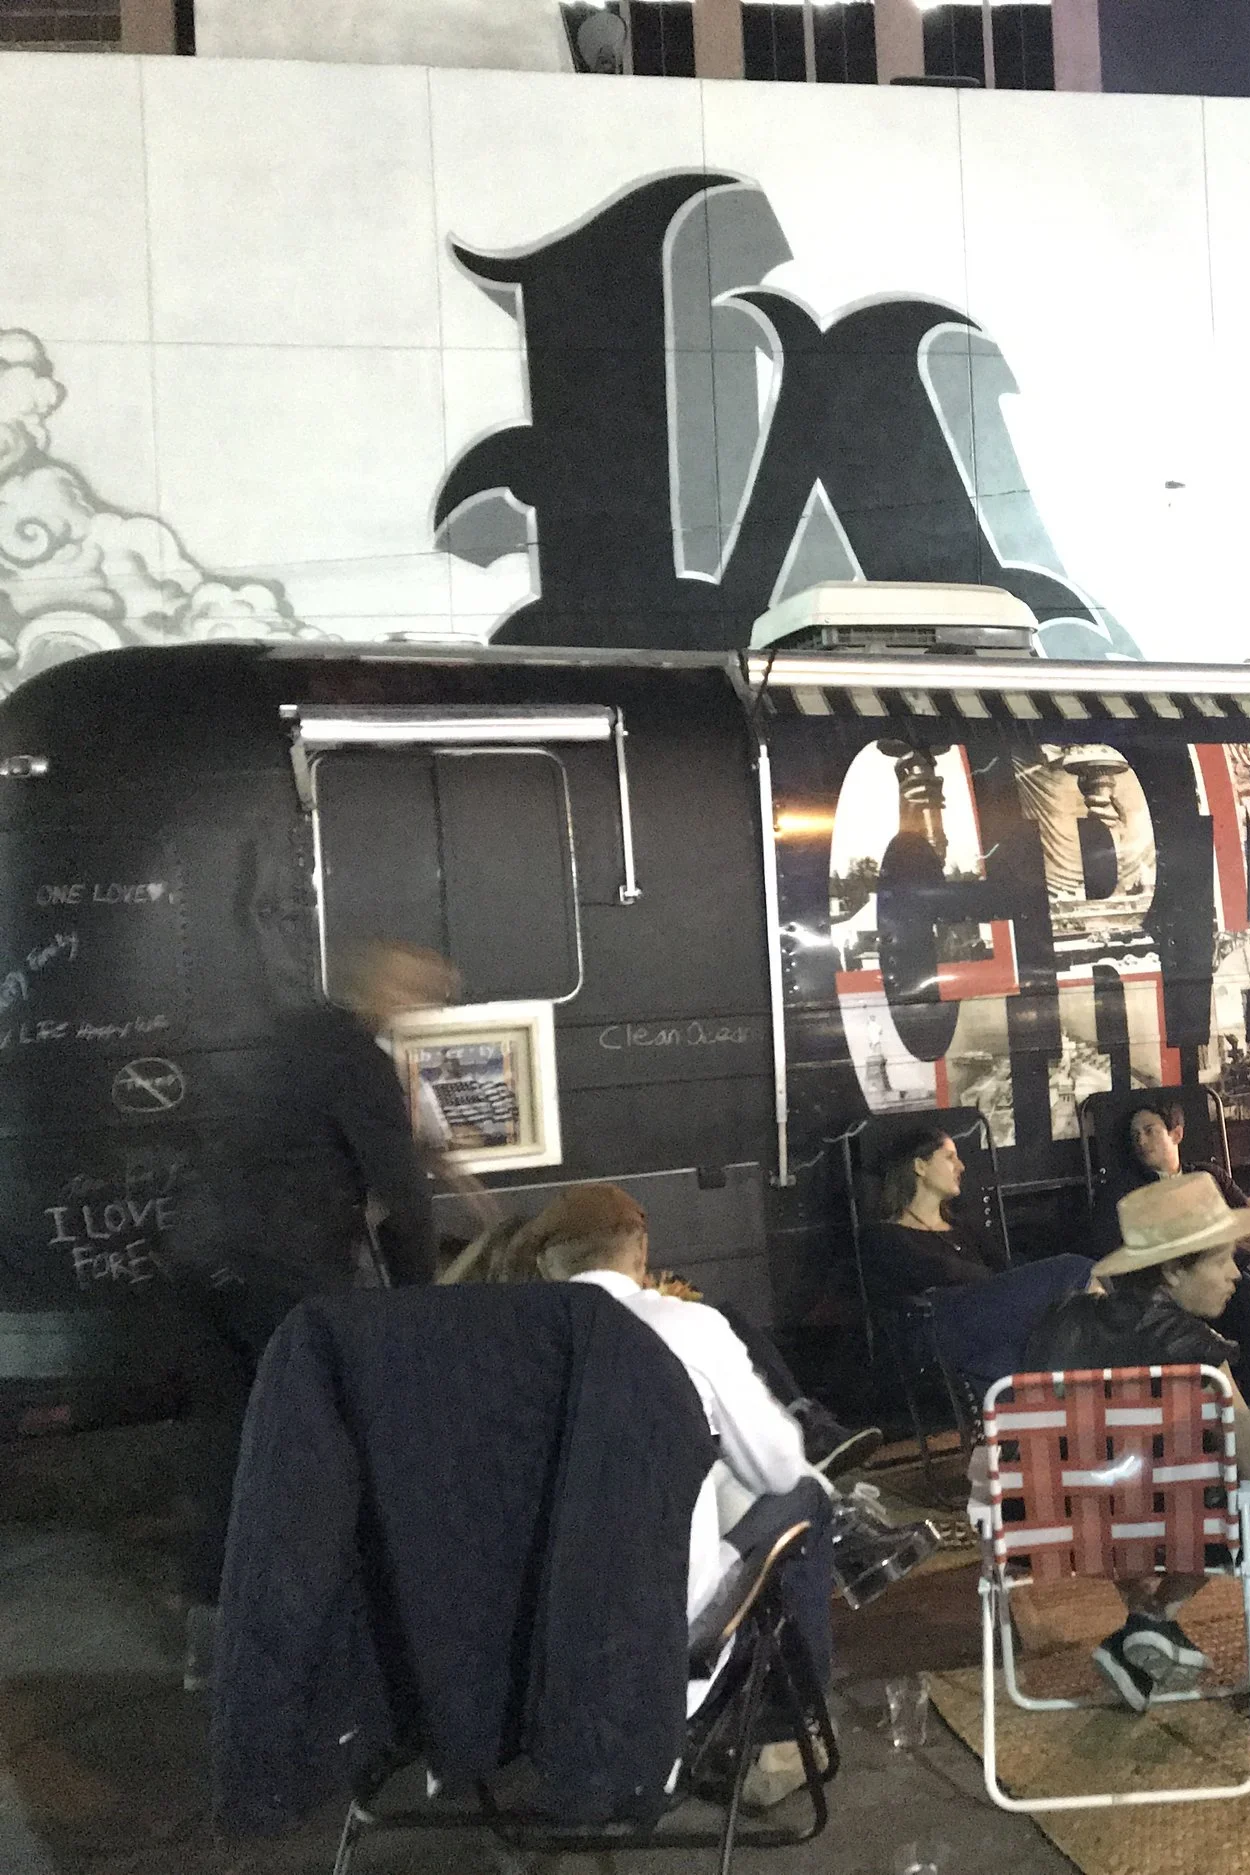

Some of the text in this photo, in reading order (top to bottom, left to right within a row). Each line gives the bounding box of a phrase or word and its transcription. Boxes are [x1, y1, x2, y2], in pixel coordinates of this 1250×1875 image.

[37, 883, 150, 906] ONE LOVE
[44, 1197, 177, 1244] I LOVE
